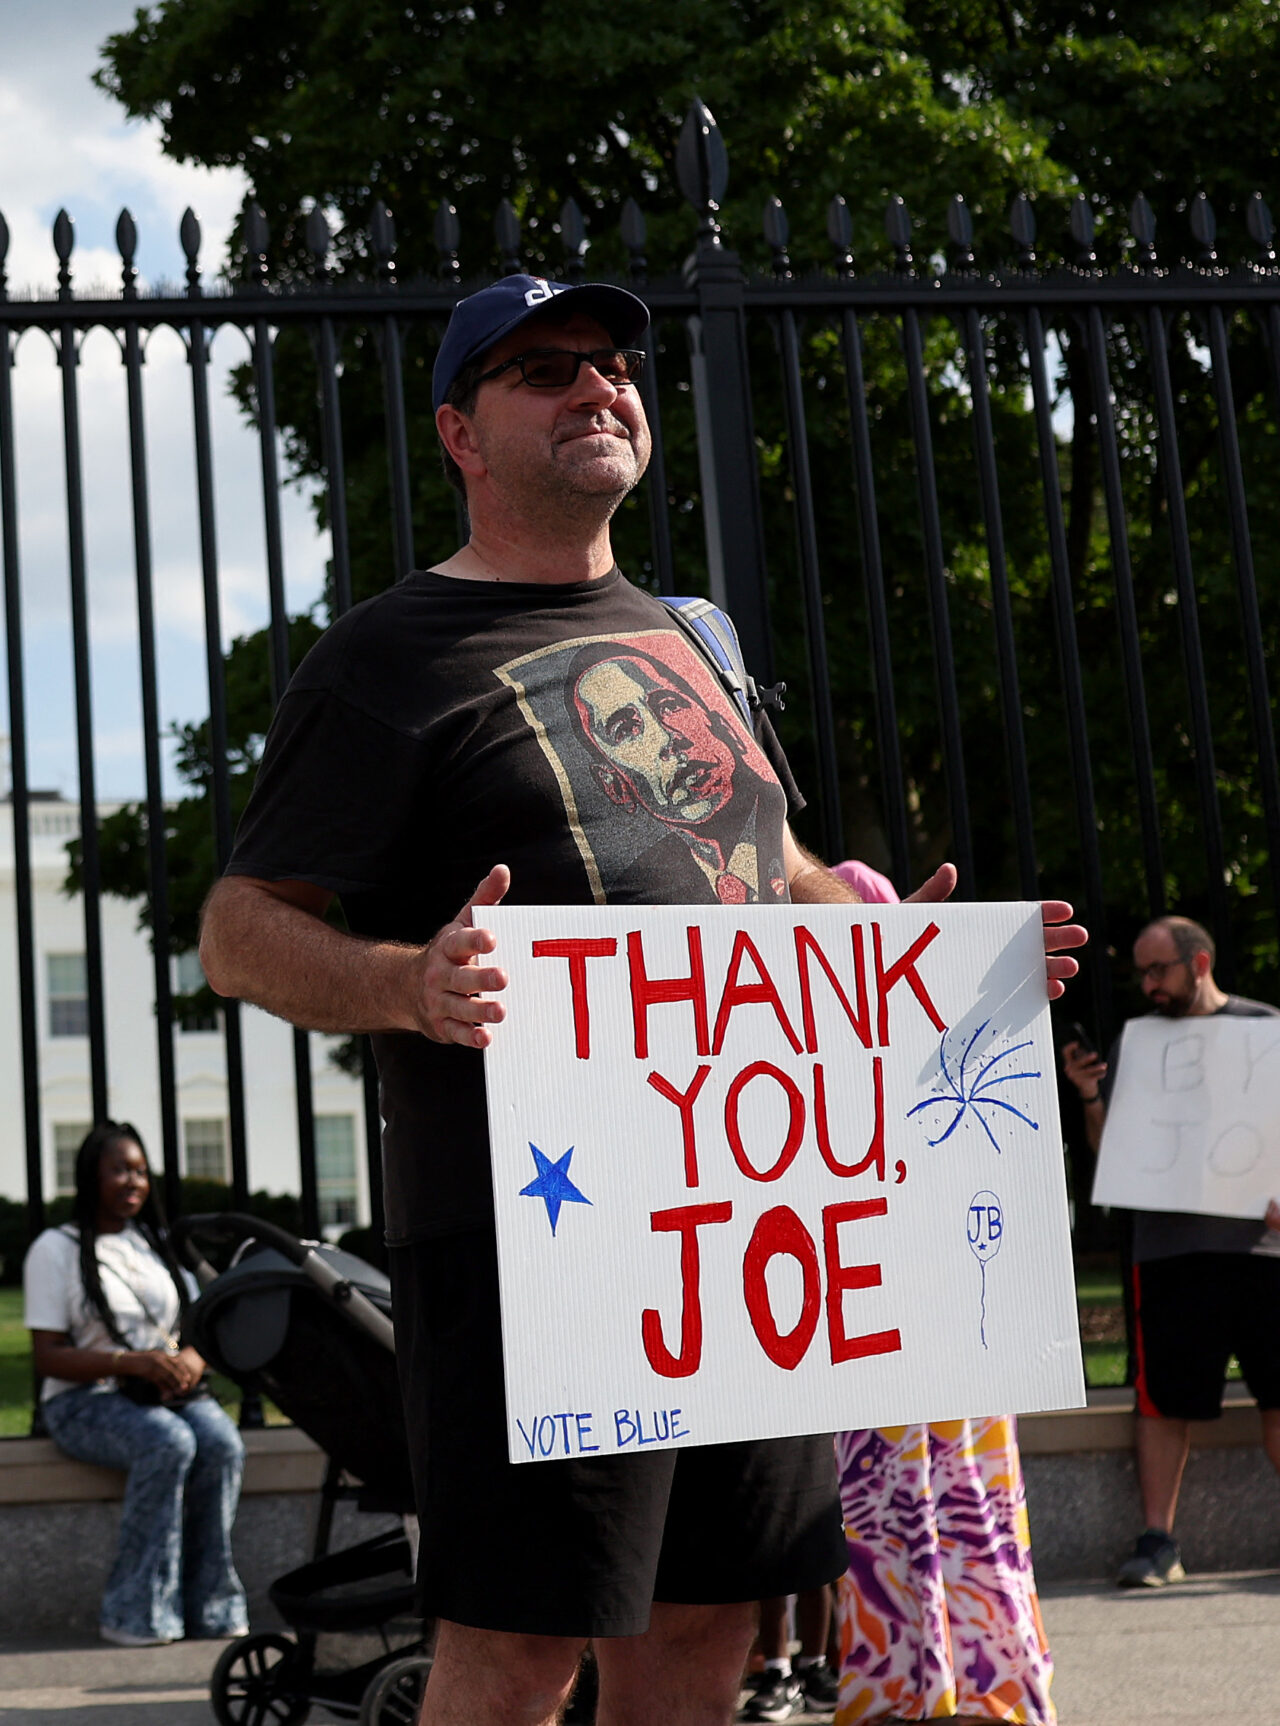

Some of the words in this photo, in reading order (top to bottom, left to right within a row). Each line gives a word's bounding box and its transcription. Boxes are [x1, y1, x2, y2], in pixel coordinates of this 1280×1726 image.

[532, 922, 948, 1060] THANK
[647, 1057, 906, 1187] YOU,
[642, 1198, 902, 1379] JOE
[966, 1205, 1003, 1244] JB
[516, 1412, 601, 1459] VOTE
[614, 1408, 690, 1448] BLUE
